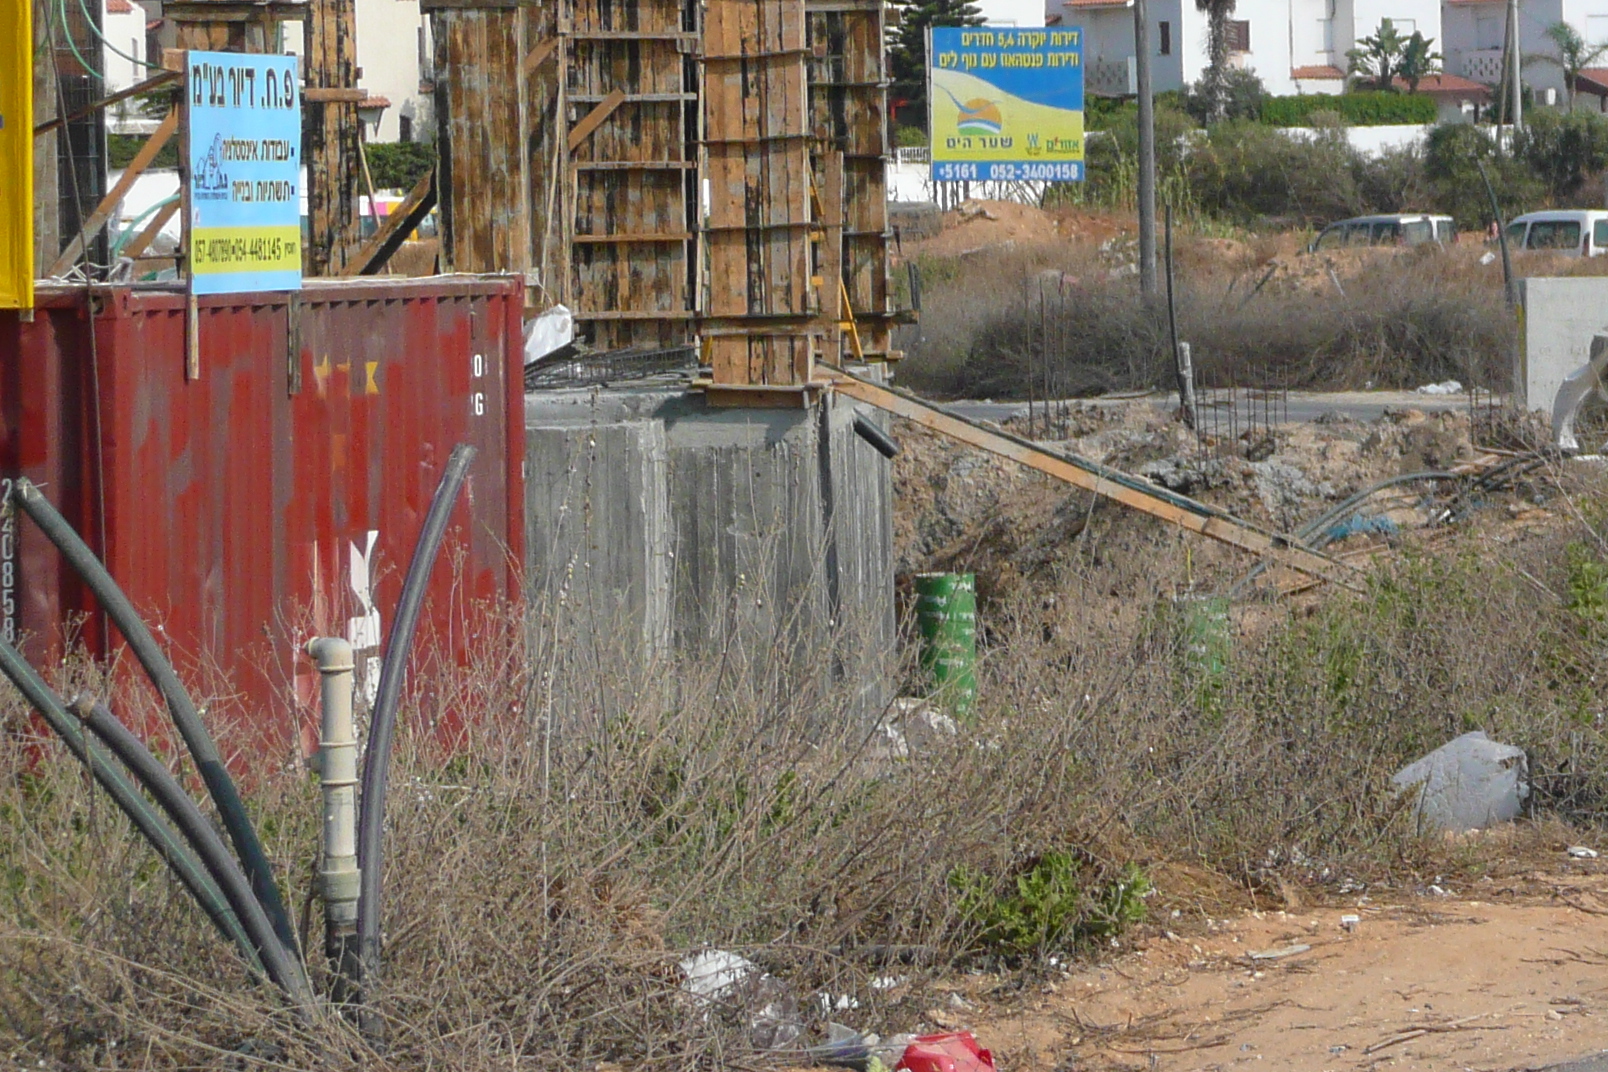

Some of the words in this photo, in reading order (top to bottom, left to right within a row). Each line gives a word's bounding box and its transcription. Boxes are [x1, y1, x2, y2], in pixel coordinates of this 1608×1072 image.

[961, 32, 995, 47] חדרים
[1017, 31, 1047, 49] יוקרה
[1050, 31, 1079, 47] דירות
[939, 50, 958, 68] לים
[961, 54, 978, 71] נוף
[981, 53, 997, 68] עם
[1001, 53, 1044, 68] פנטהאוז
[1047, 52, 1079, 67] ודירות
[228, 66, 256, 107] דיור
[261, 139, 290, 162] עבודות
[946, 136, 972, 149] הים
[978, 136, 1013, 149] שער
[989, 163, 1079, 179] 052-3400158
[256, 180, 290, 202] תשתיות
